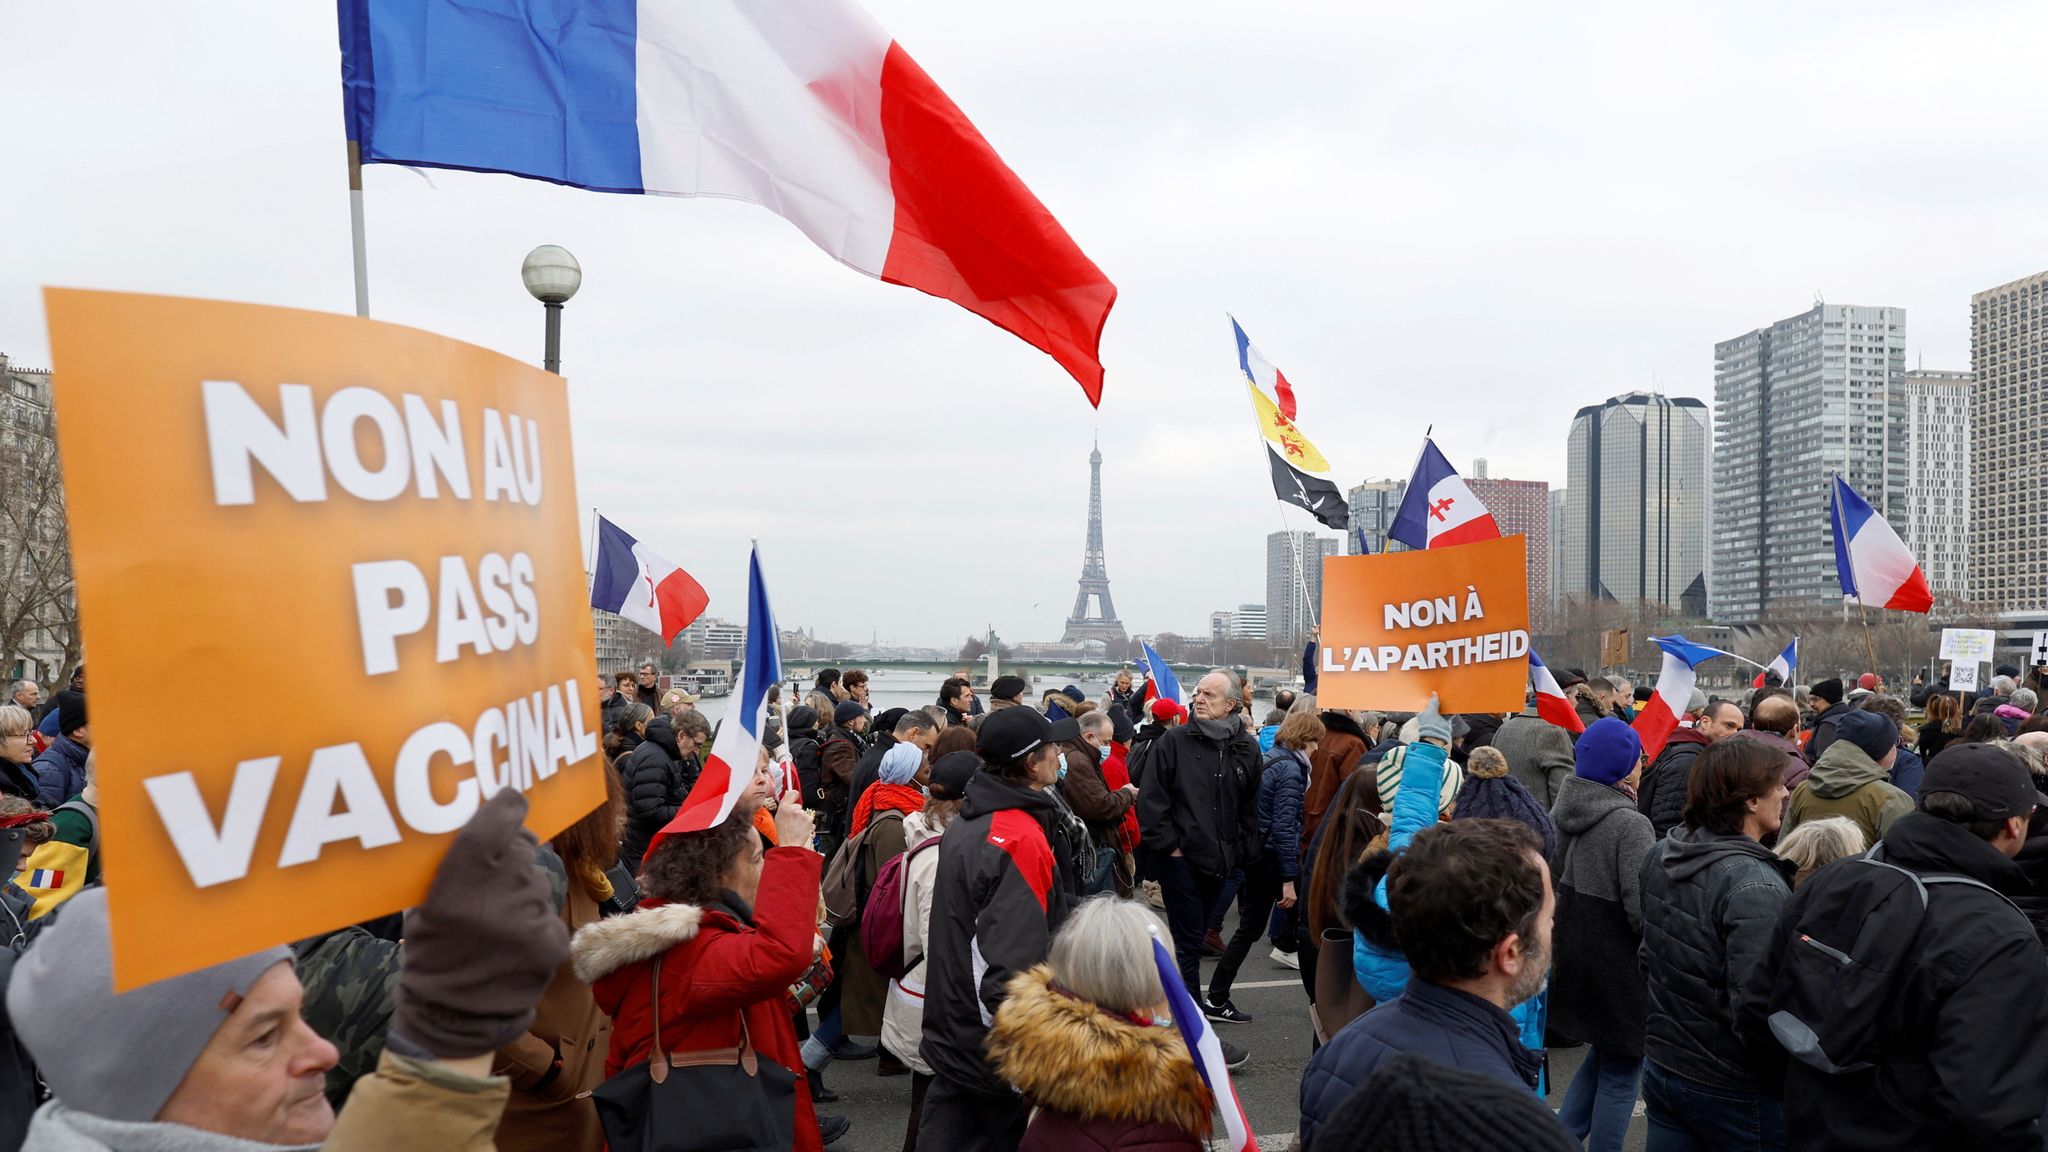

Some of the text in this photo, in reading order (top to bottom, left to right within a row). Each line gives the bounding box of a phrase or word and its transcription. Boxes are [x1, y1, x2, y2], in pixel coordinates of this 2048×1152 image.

[202, 380, 543, 506] NON AU
[351, 552, 539, 676] PASS
[1322, 629, 1530, 672] L'APARTHEID
[1384, 585, 1484, 630] NON À
[143, 679, 597, 888] VACCINAL
